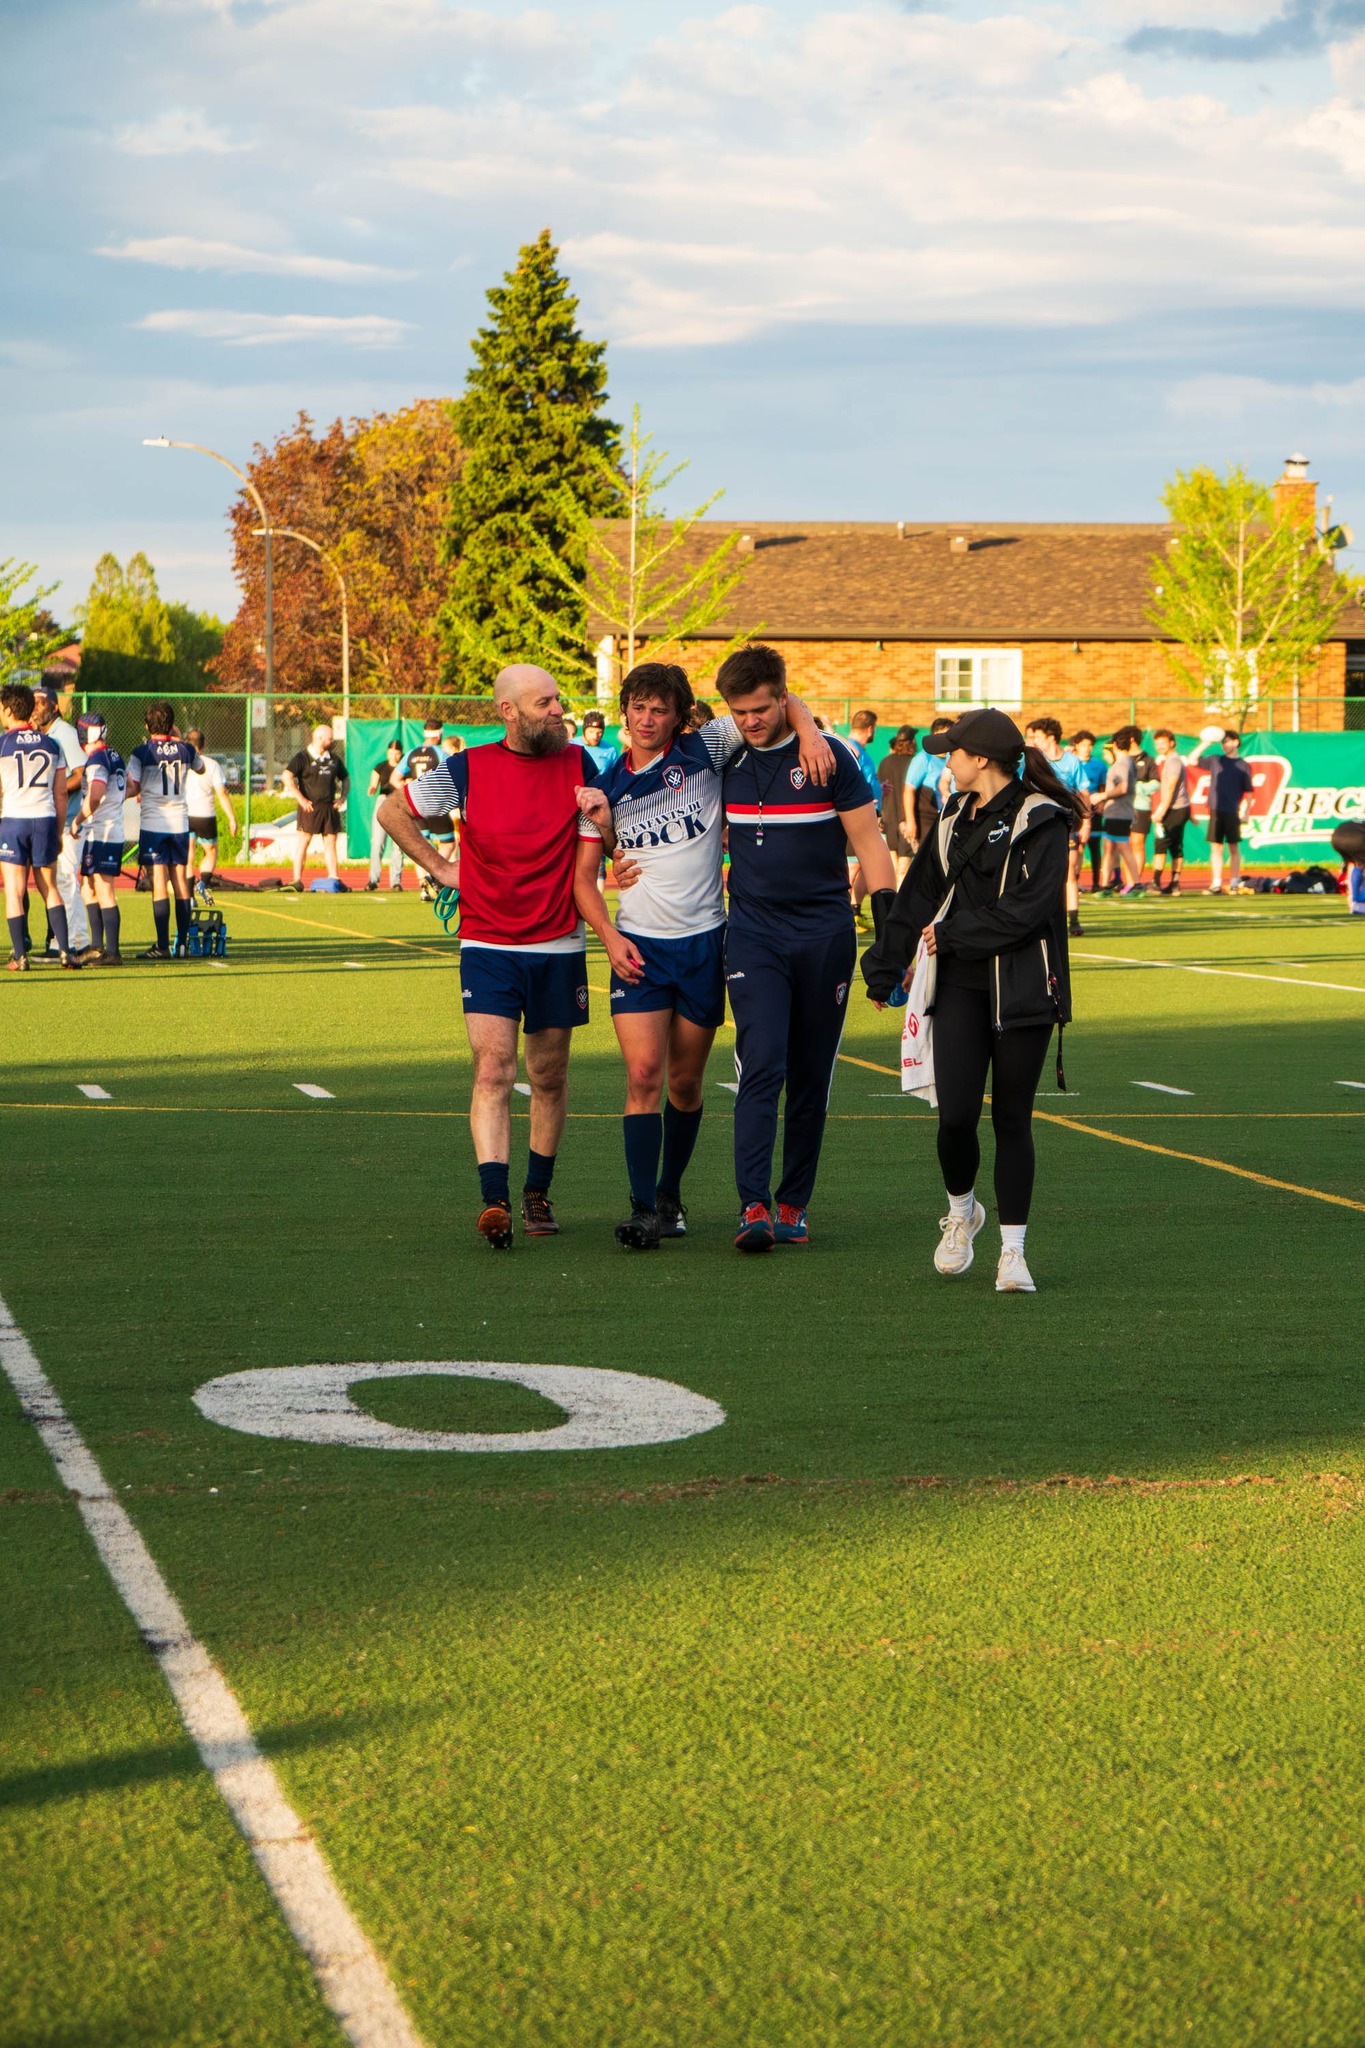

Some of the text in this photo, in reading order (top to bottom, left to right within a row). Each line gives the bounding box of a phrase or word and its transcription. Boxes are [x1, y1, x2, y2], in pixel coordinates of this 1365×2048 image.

[13, 750, 52, 789] 12
[160, 761, 181, 796] 11
[1281, 792, 1365, 814] BEC
[631, 808, 685, 834] ENFANTS
[901, 1057, 923, 1068] EL
